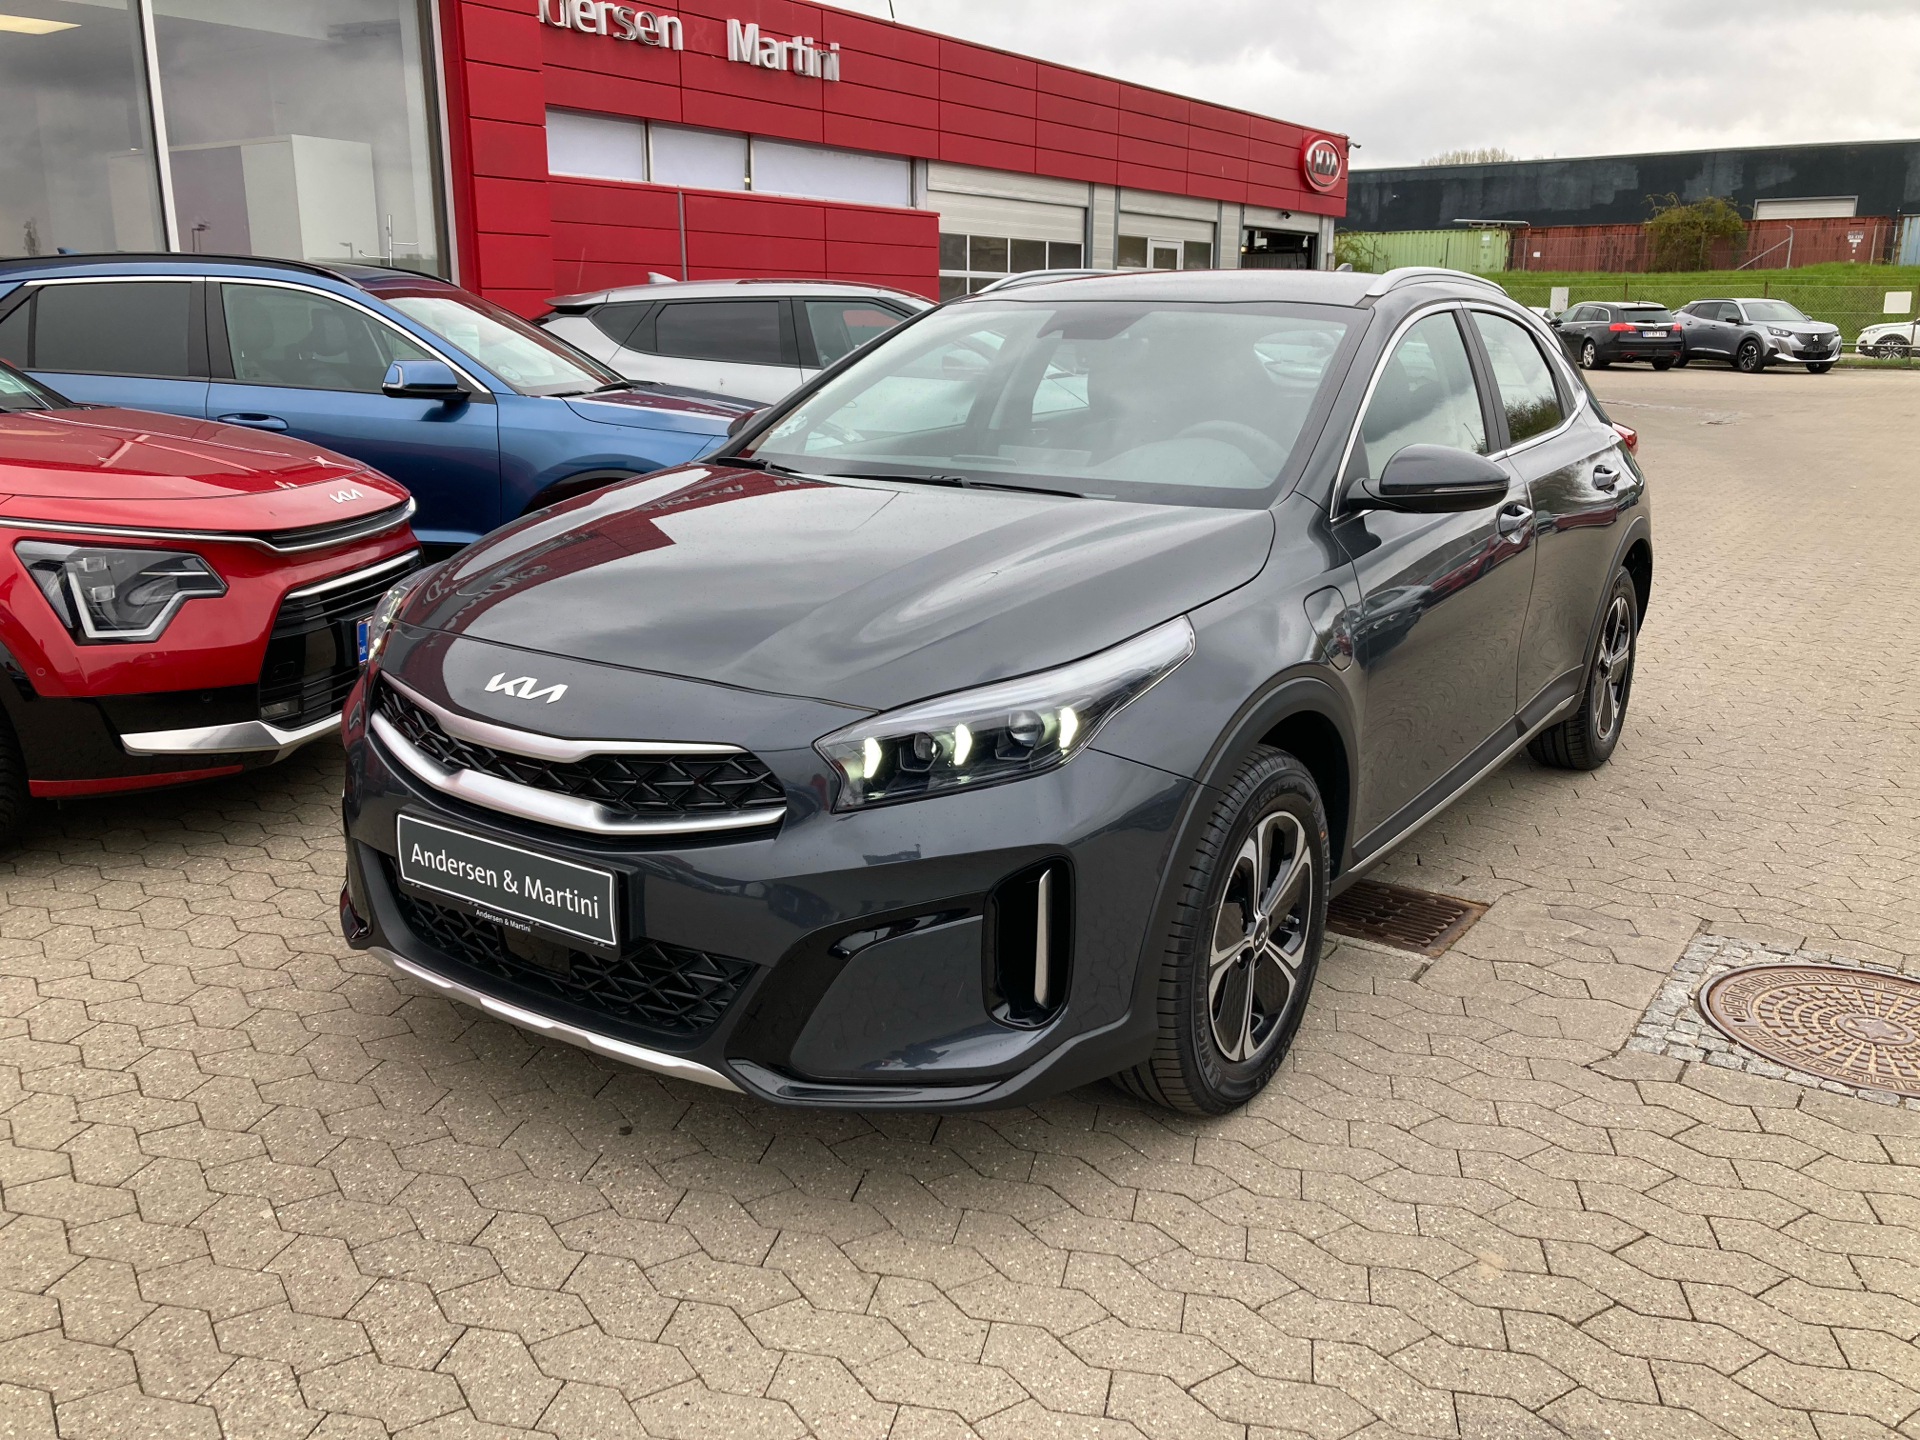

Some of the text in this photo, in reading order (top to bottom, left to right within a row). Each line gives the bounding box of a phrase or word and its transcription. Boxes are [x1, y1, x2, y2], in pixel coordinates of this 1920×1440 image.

[726, 18, 840, 81] Martini
[484, 672, 569, 704] KIA
[411, 843, 599, 920] Andersen & Martini
[476, 909, 531, 932] Andersen & Martini
